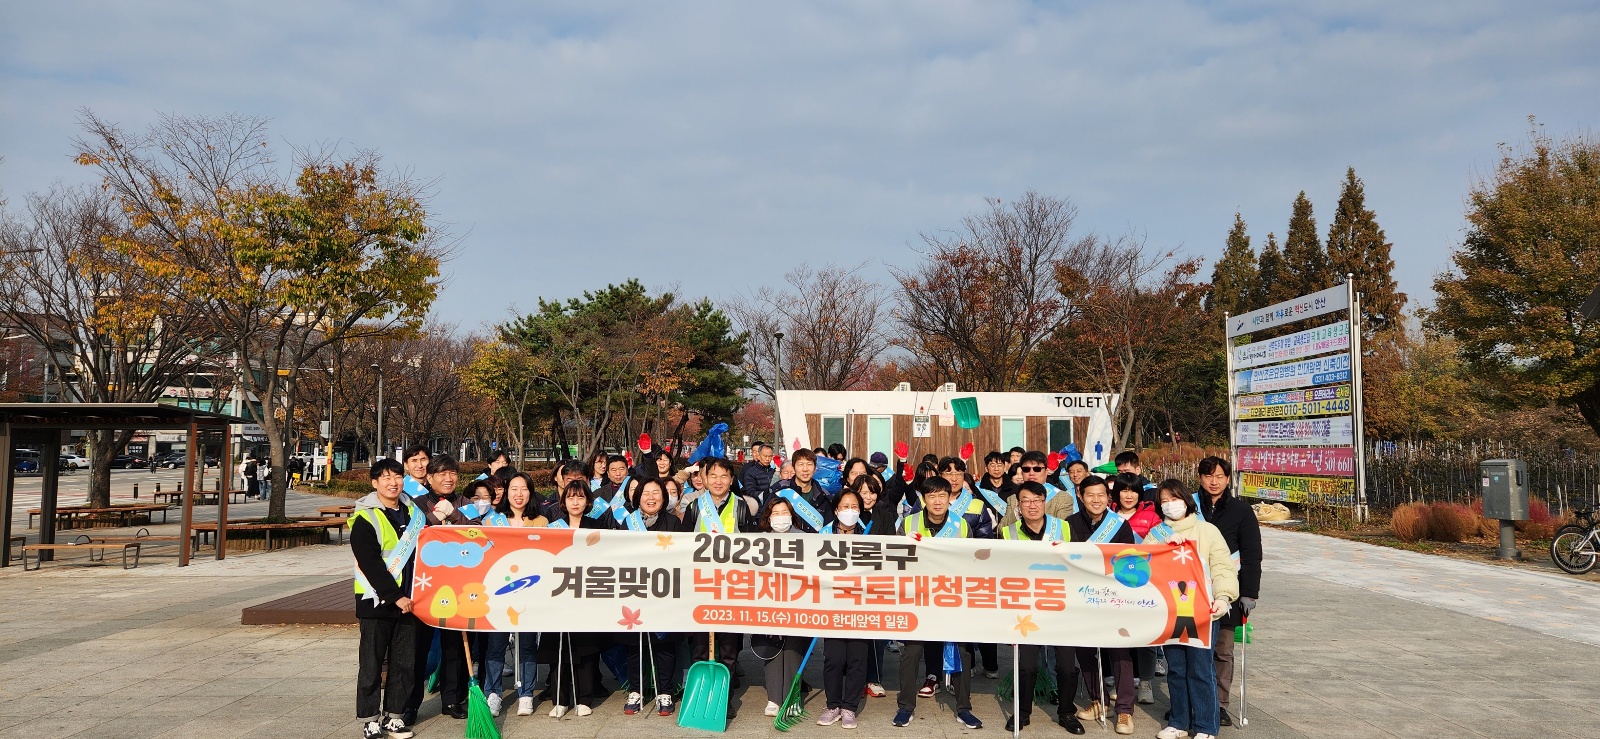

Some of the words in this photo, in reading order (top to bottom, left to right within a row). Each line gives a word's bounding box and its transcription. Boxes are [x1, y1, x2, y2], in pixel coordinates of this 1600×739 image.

[1252, 315, 1264, 326] 시민과
[1276, 306, 1293, 319] 자유로운
[1294, 301, 1313, 314] 혁신도시
[1314, 297, 1326, 310] 안산
[1297, 360, 1321, 376] 한대앞역
[1323, 355, 1350, 372] 신축이전
[1054, 396, 1102, 408] TOILET
[1283, 399, 1350, 416] 010-5011-4448
[1243, 473, 1265, 488] 국가지원
[692, 532, 805, 570] 2023년
[816, 539, 919, 571] 상록구
[550, 566, 681, 599] 겨울맞이
[693, 568, 821, 604] 낙엽제거
[832, 575, 1067, 612] 국토대청결운동
[702, 608, 736, 622] 2023.
[739, 609, 753, 622] 11.
[756, 611, 791, 626] 15.(수)
[794, 612, 829, 626] 10:00
[832, 613, 881, 629] 한대앞역
[884, 614, 909, 629] 일원
